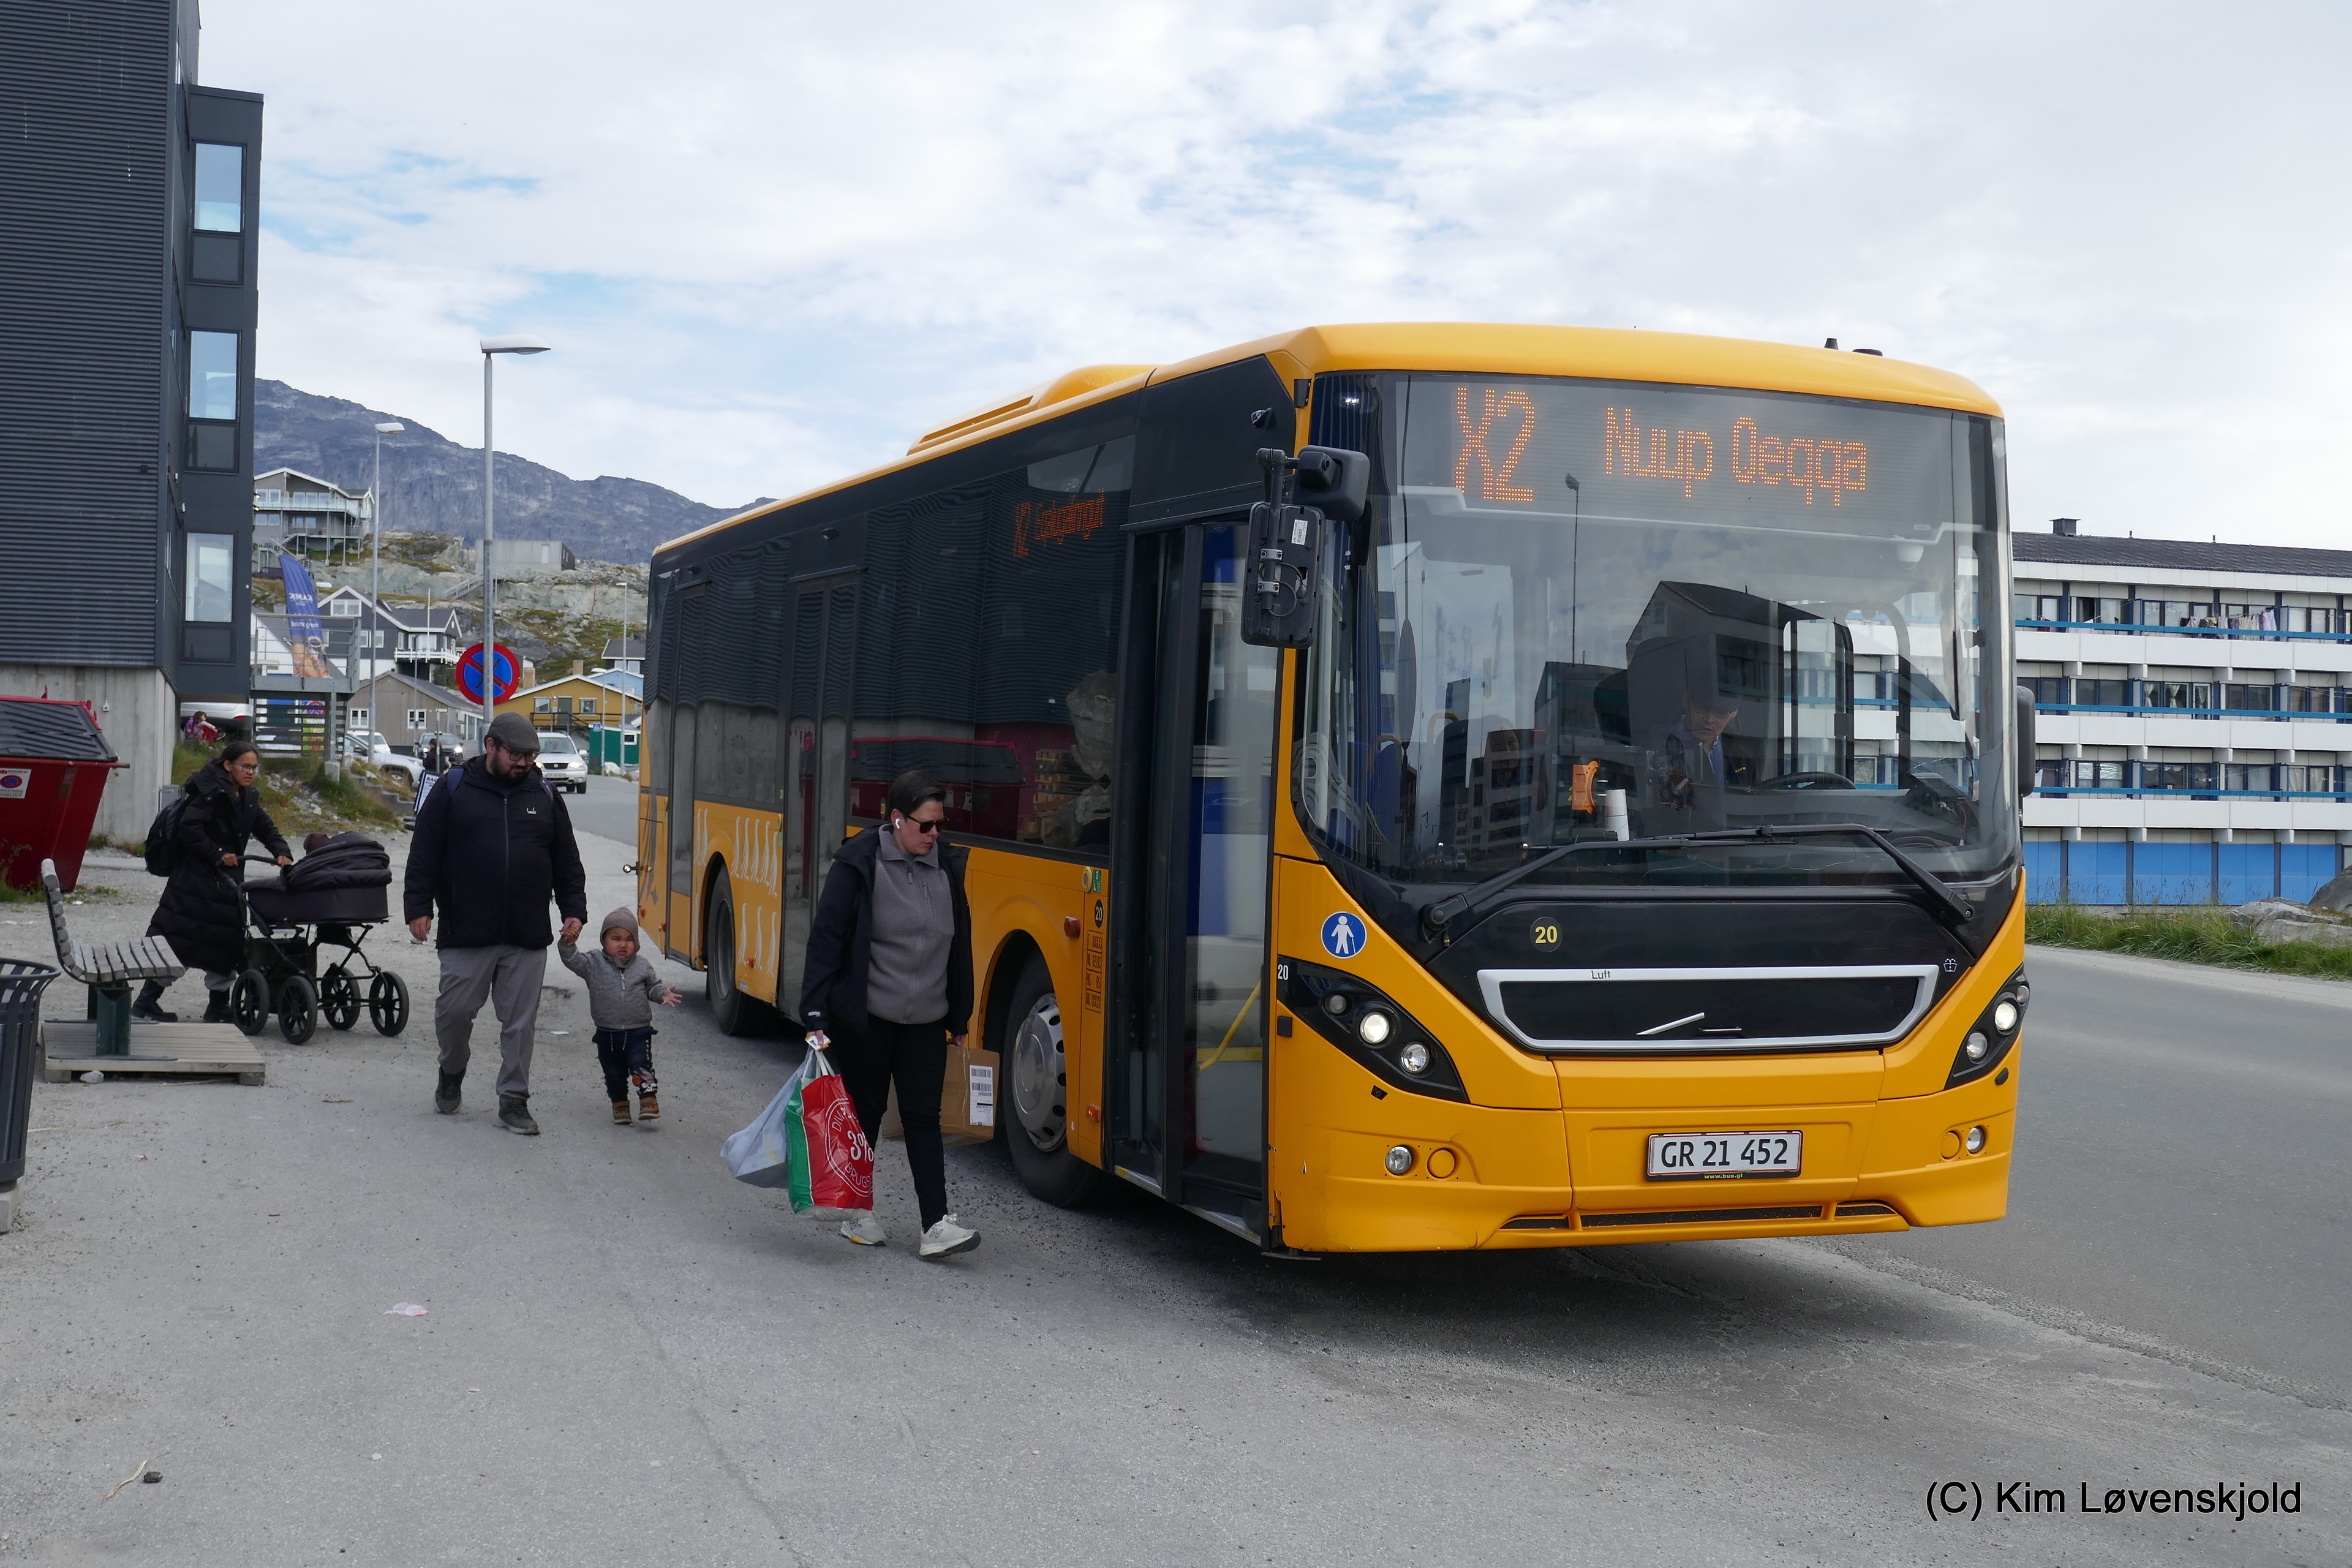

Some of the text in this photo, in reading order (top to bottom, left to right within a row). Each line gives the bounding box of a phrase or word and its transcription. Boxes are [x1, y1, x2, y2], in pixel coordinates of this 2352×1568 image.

[1456, 386, 1535, 502] X2
[1606, 407, 1867, 507] Nuup Qeqqa
[1095, 906, 1102, 921] 20
[1535, 925, 1558, 944] 20
[1278, 964, 1289, 981] 20
[1591, 970, 1611, 979] Luft
[846, 1130, 874, 1163] 3%
[1660, 1138, 1789, 1168] GR 21 452
[845, 1161, 873, 1188] BRUGS
